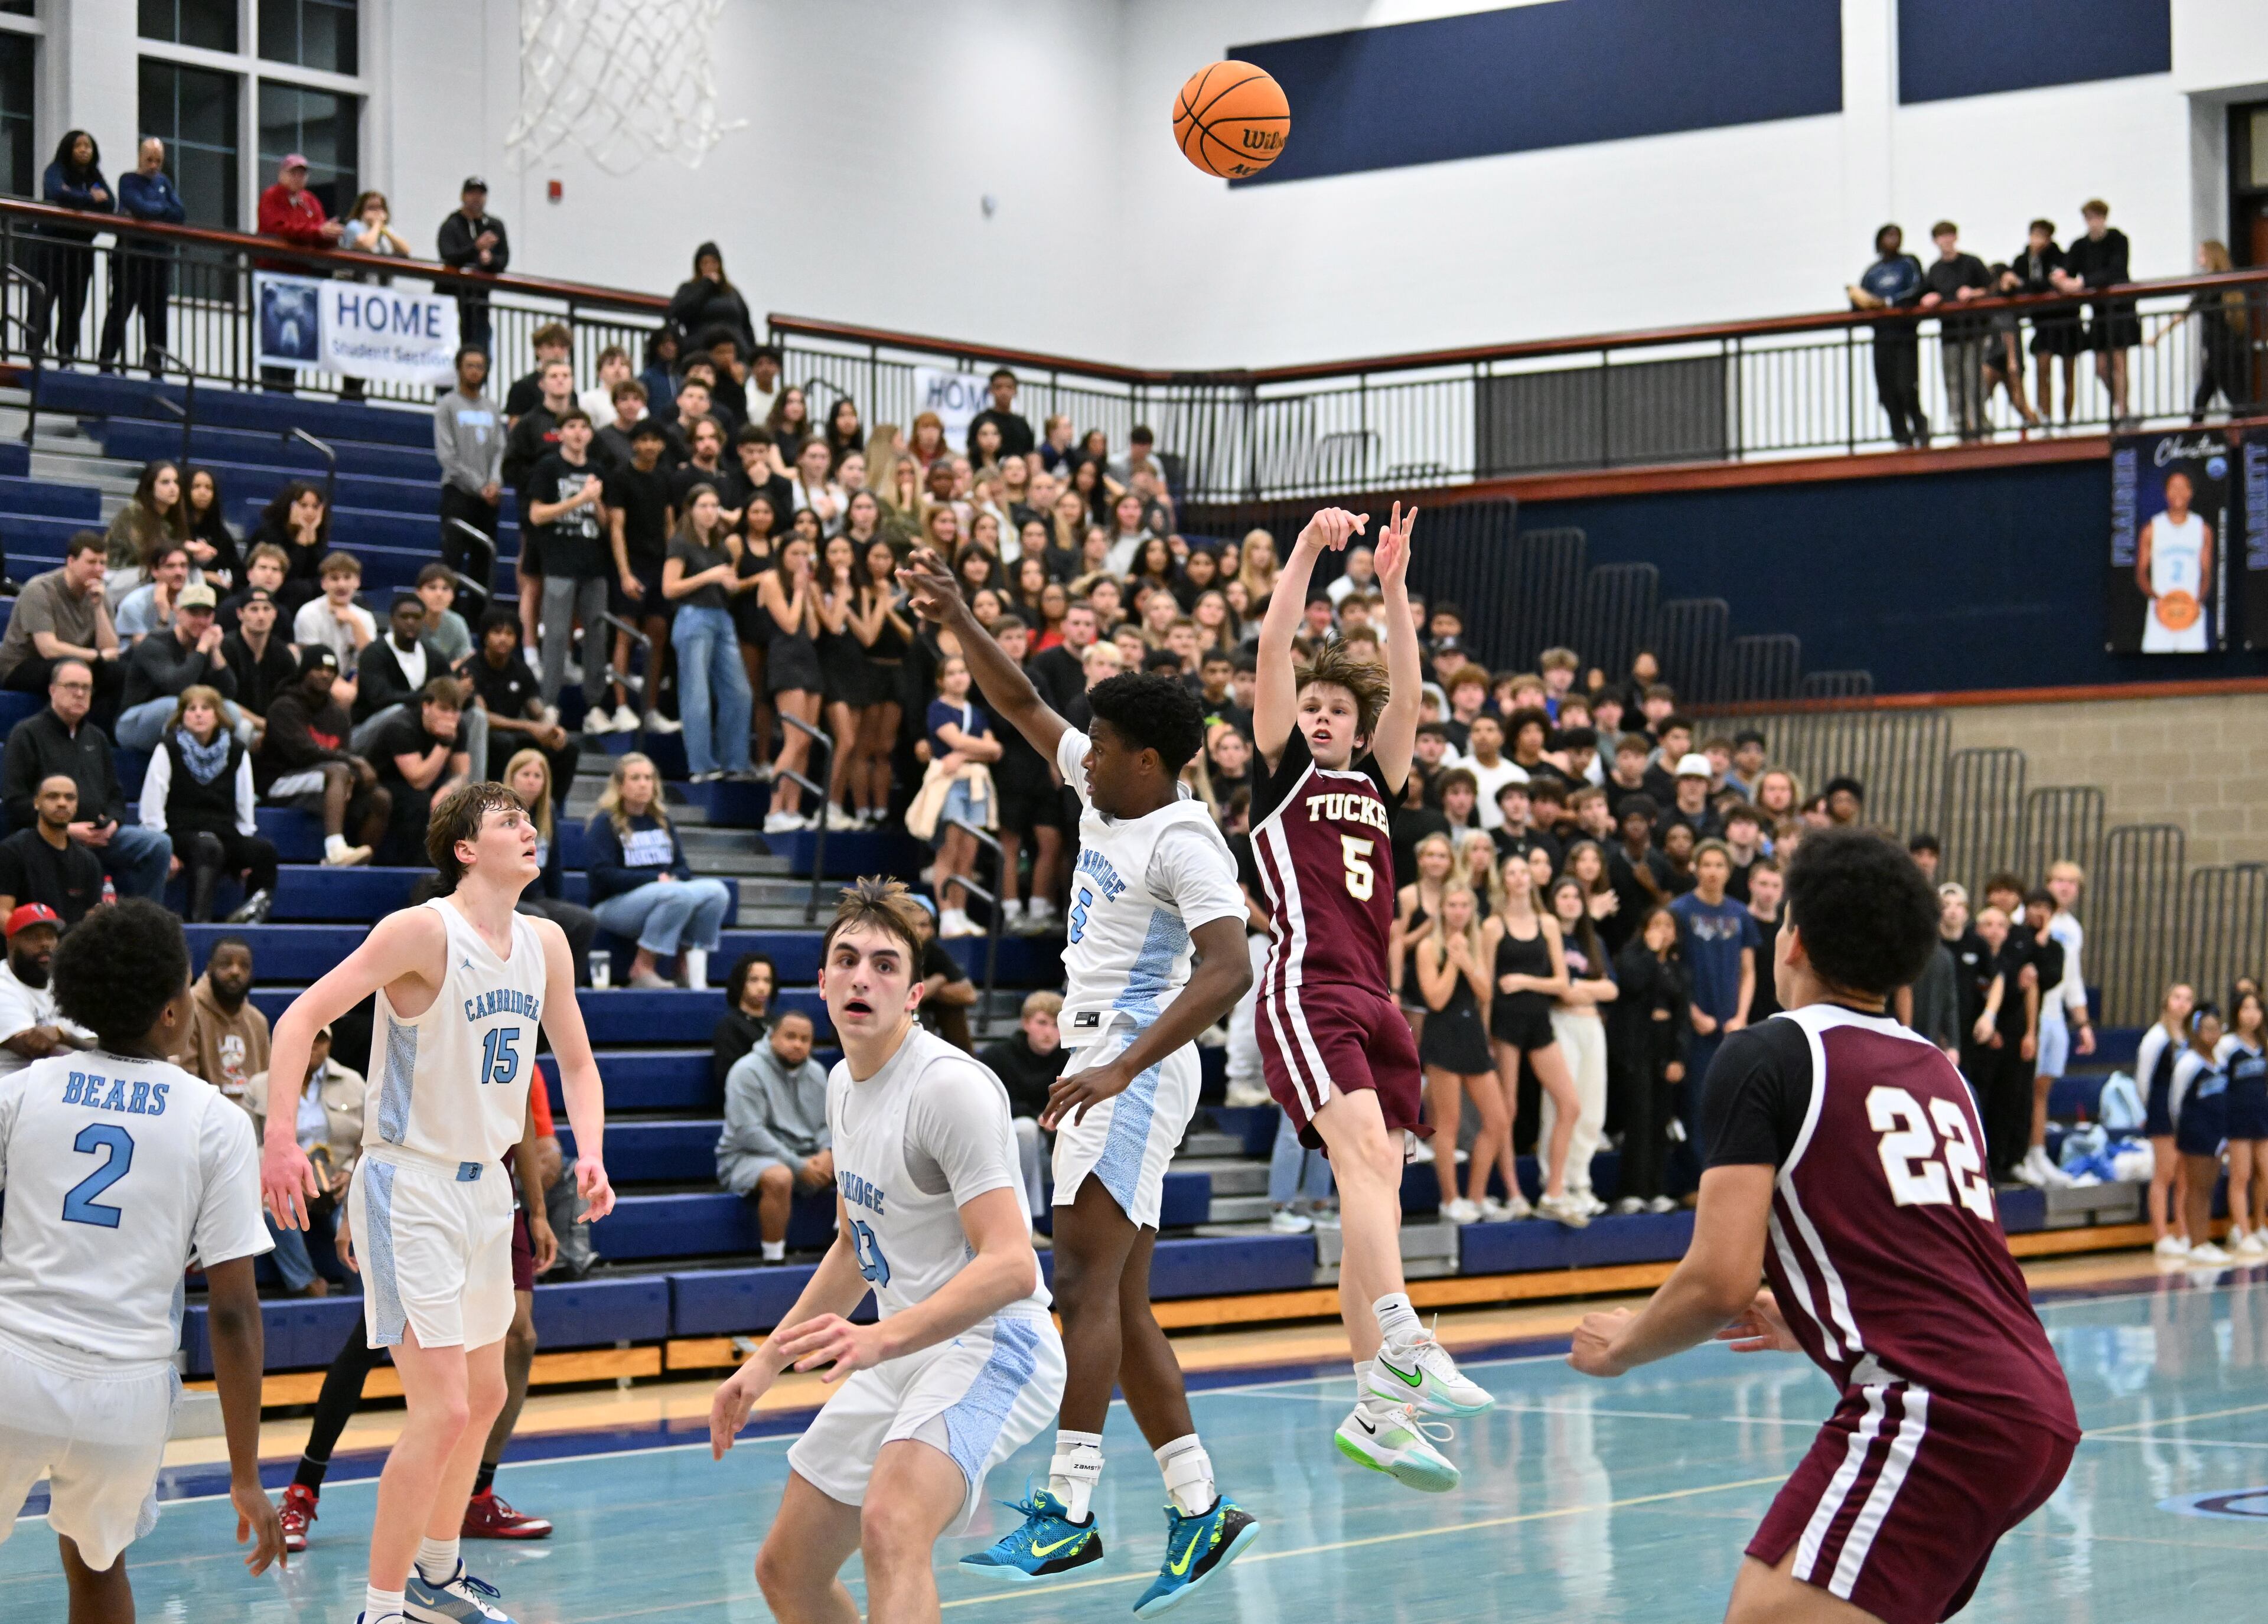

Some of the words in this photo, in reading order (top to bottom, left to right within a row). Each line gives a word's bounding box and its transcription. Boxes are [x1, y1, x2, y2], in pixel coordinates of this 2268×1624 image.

[337, 293, 441, 338] HOME
[927, 374, 991, 411] HOM
[1306, 793, 1390, 840] TUCKE
[1340, 834, 1374, 902] 5
[1070, 886, 1093, 944] 5
[464, 988, 540, 1023] CAMBRIDGE
[481, 1027, 520, 1084] 15
[62, 1071, 170, 1116] BEARS
[61, 1123, 135, 1229] 2
[1865, 1085, 1995, 1223] 22
